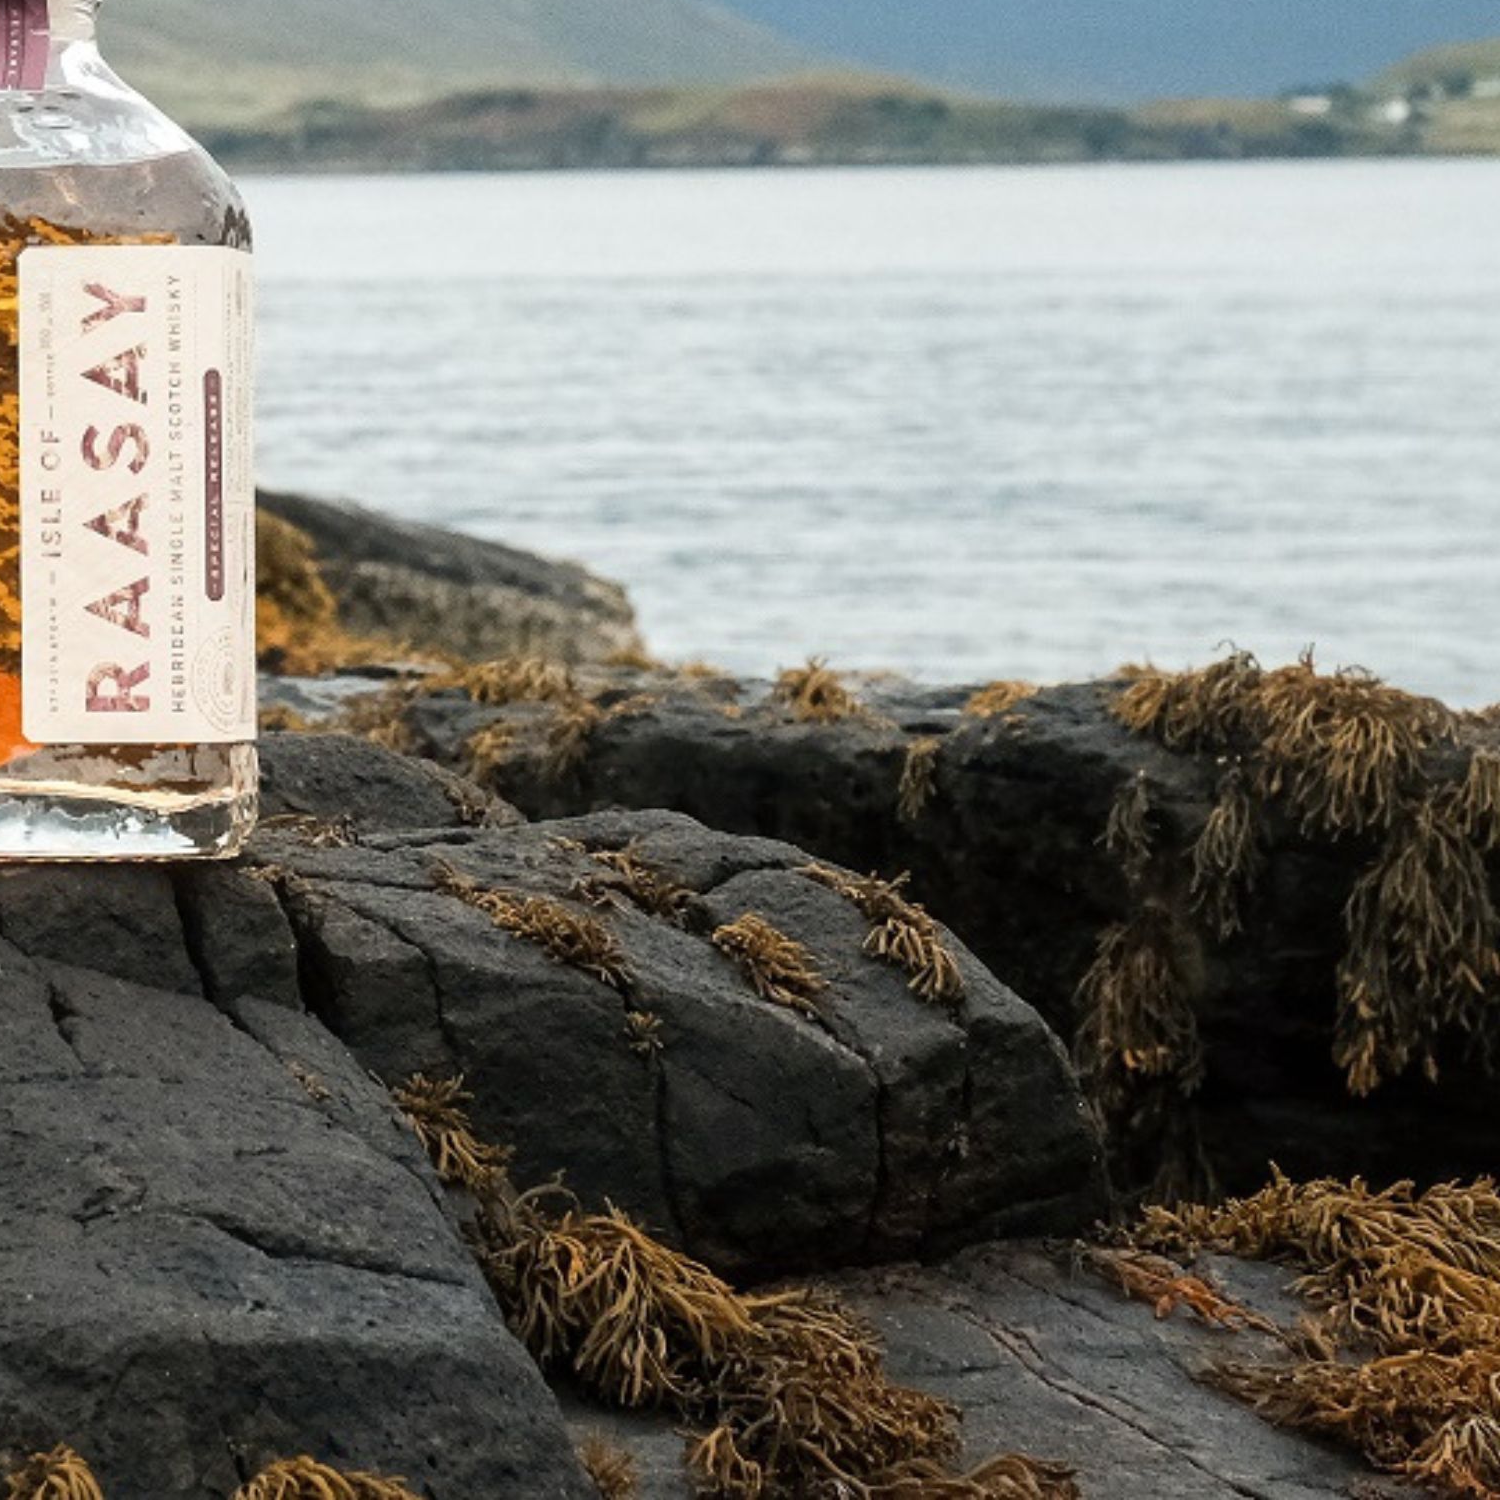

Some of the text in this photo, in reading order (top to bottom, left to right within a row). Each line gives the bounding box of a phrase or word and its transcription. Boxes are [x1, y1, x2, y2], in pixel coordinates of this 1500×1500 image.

[41, 430, 61, 558] ISLE OF
[79, 280, 150, 712] RAASAY
[168, 275, 185, 712] HEBRIDEAN SINGLE MALT SCOTCH WHISKY
[209, 394, 220, 579] SPECIAL RELEASE
